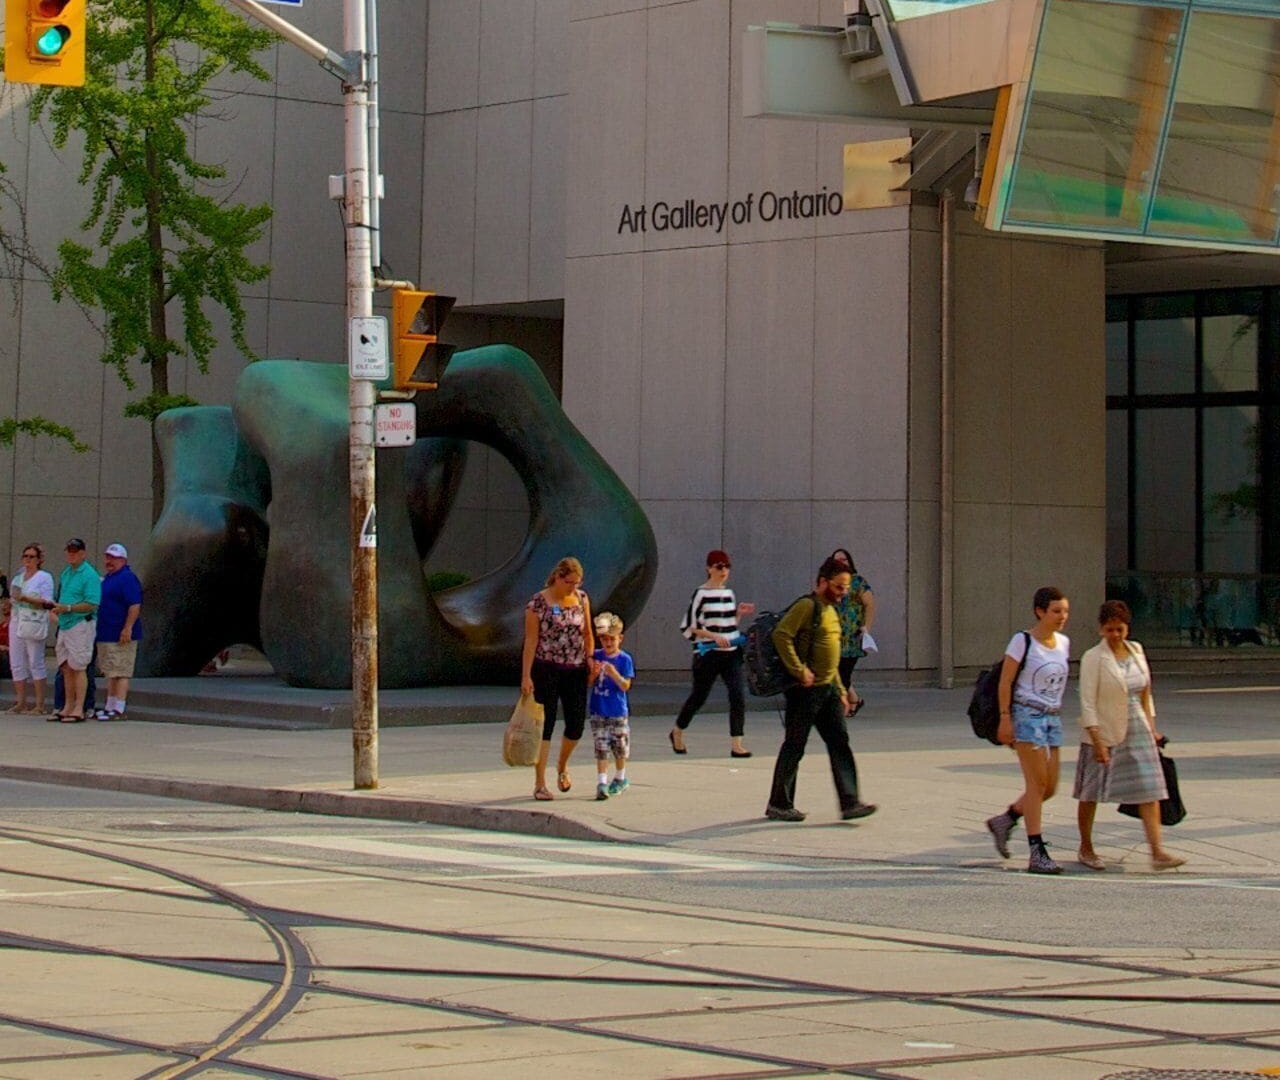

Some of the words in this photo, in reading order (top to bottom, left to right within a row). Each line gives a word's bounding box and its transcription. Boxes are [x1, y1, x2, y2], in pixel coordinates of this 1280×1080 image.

[618, 205, 646, 234] Art
[652, 200, 729, 233] Gallery
[732, 193, 754, 224] of
[759, 186, 843, 222] Ontario
[389, 408, 402, 418] NO
